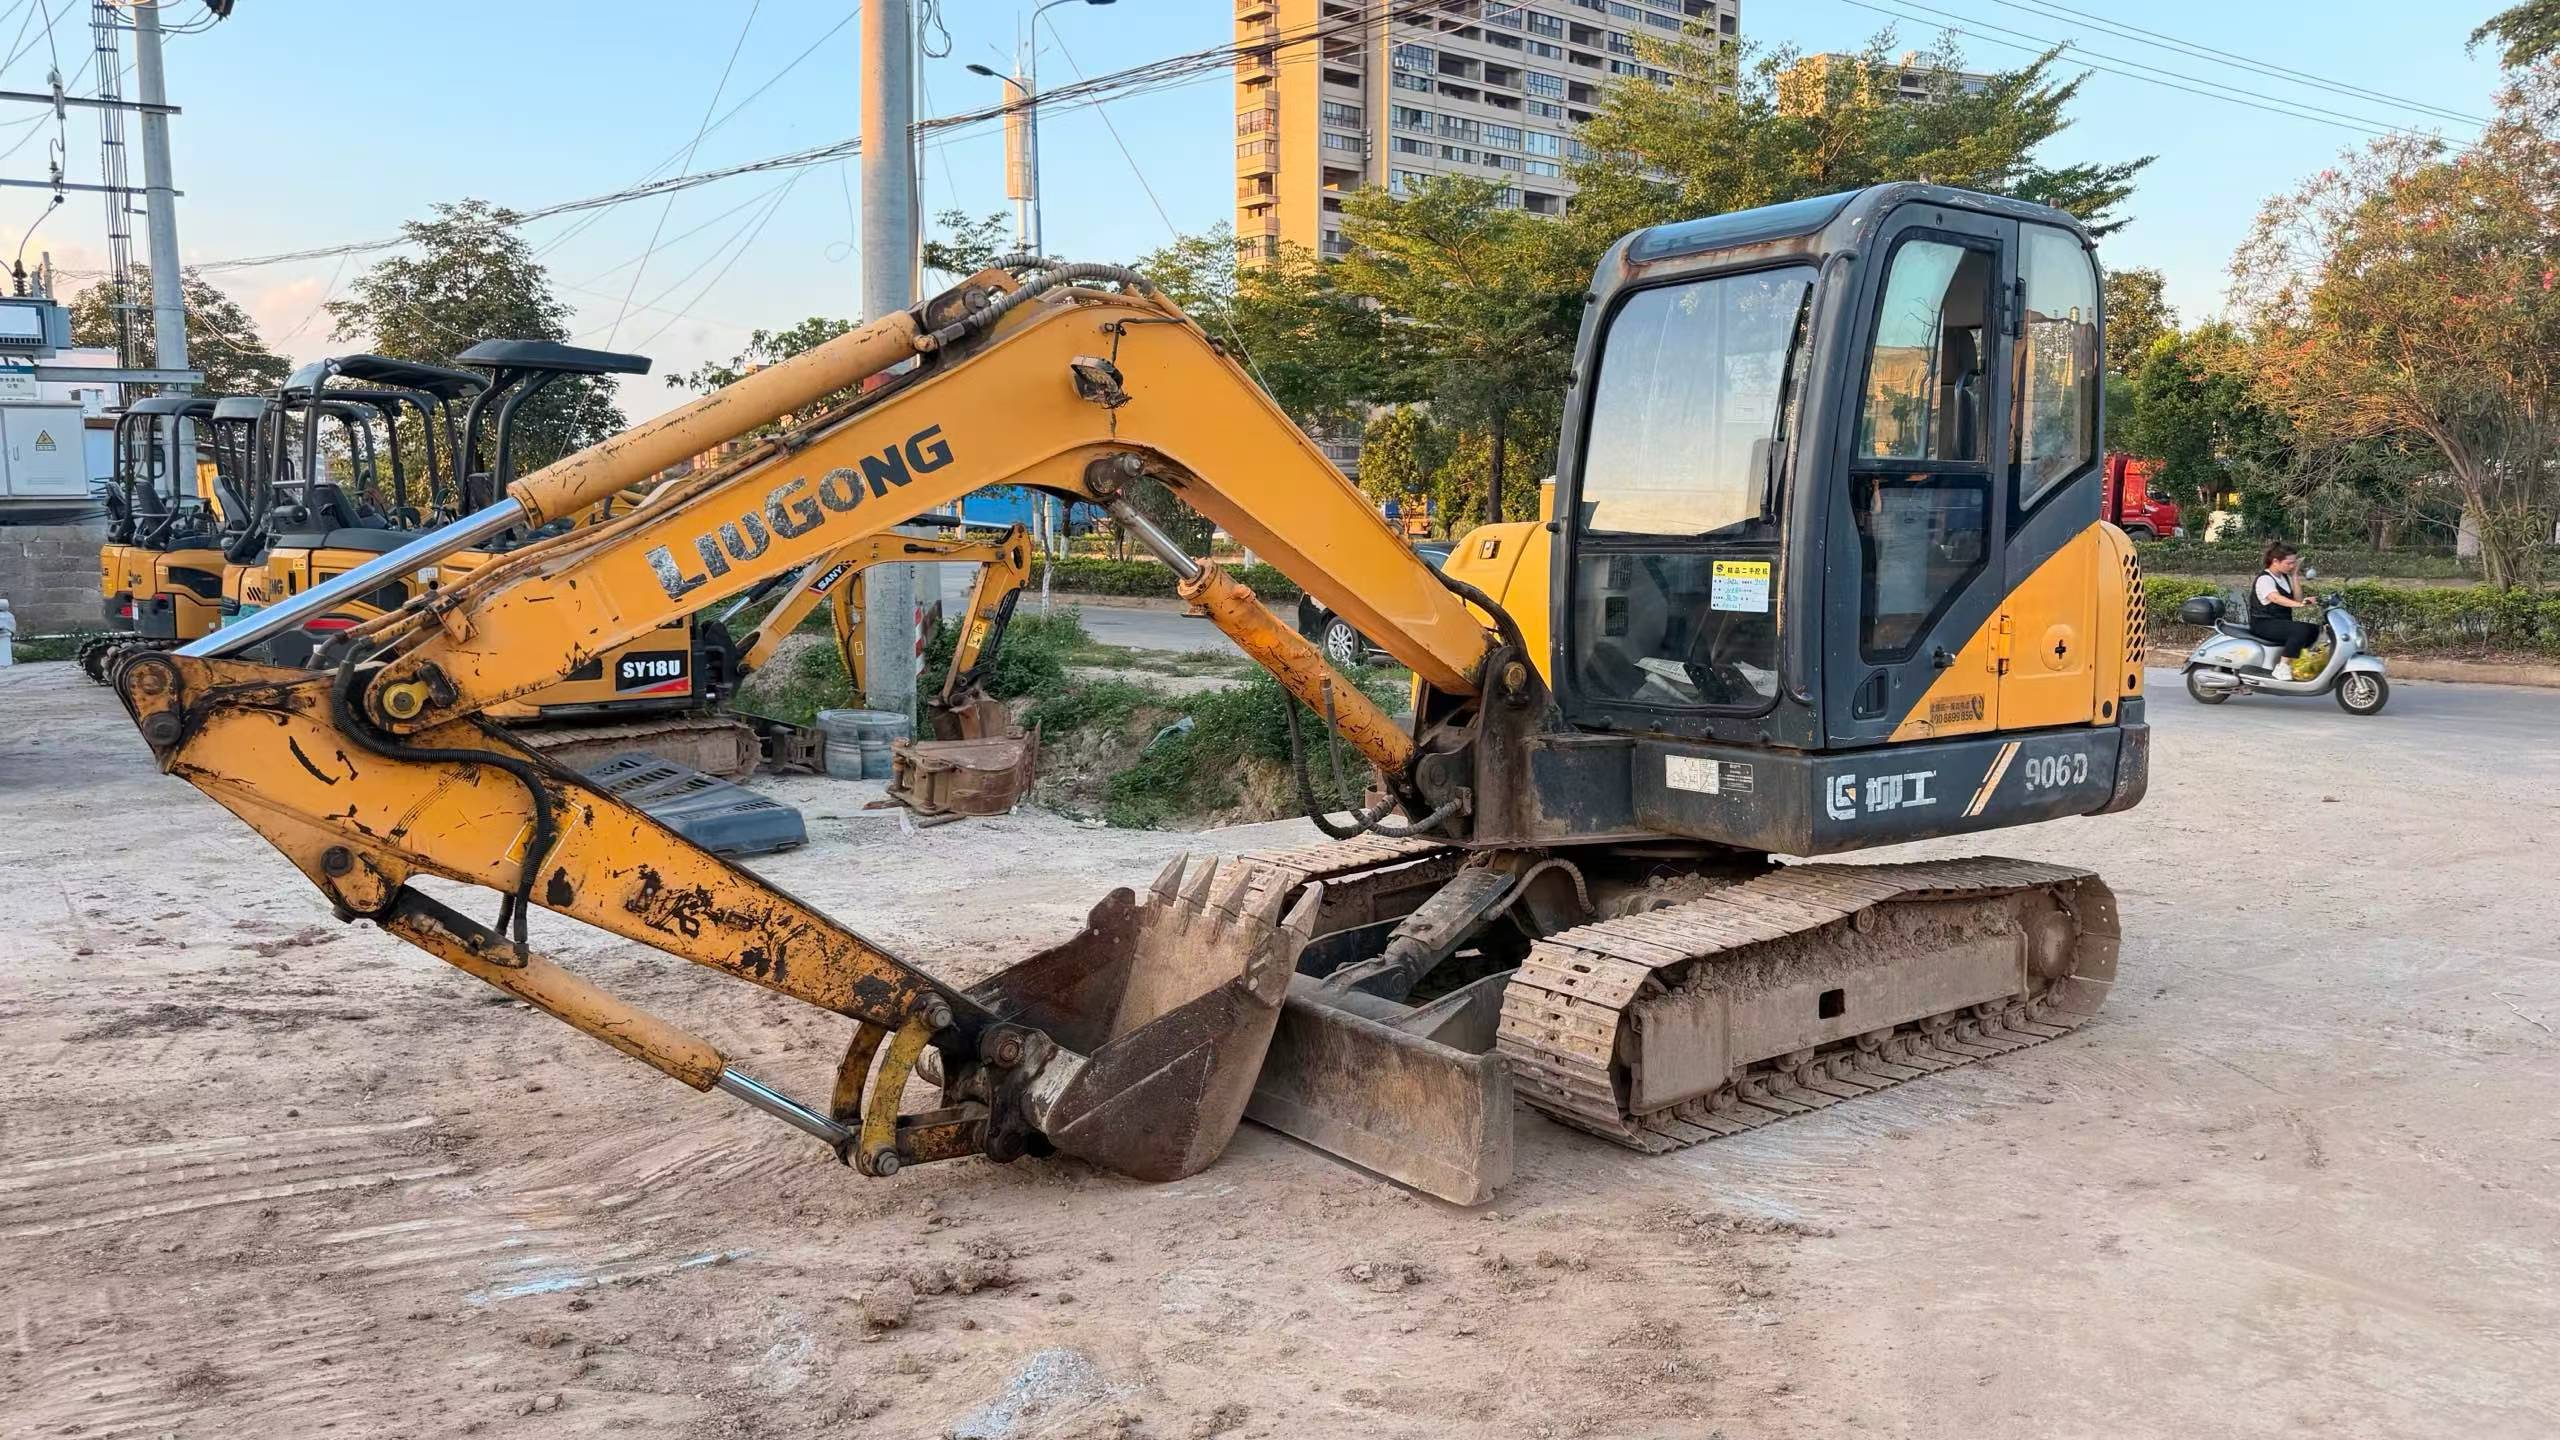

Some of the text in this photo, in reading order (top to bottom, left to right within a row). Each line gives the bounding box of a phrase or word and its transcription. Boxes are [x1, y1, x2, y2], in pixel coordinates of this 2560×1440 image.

[645, 424, 954, 599] LIUGONG
[817, 565, 843, 590] SANY
[622, 660, 681, 679] SY18U
[2025, 753, 2088, 791] 906D
[1865, 770, 1937, 813] 柳工
